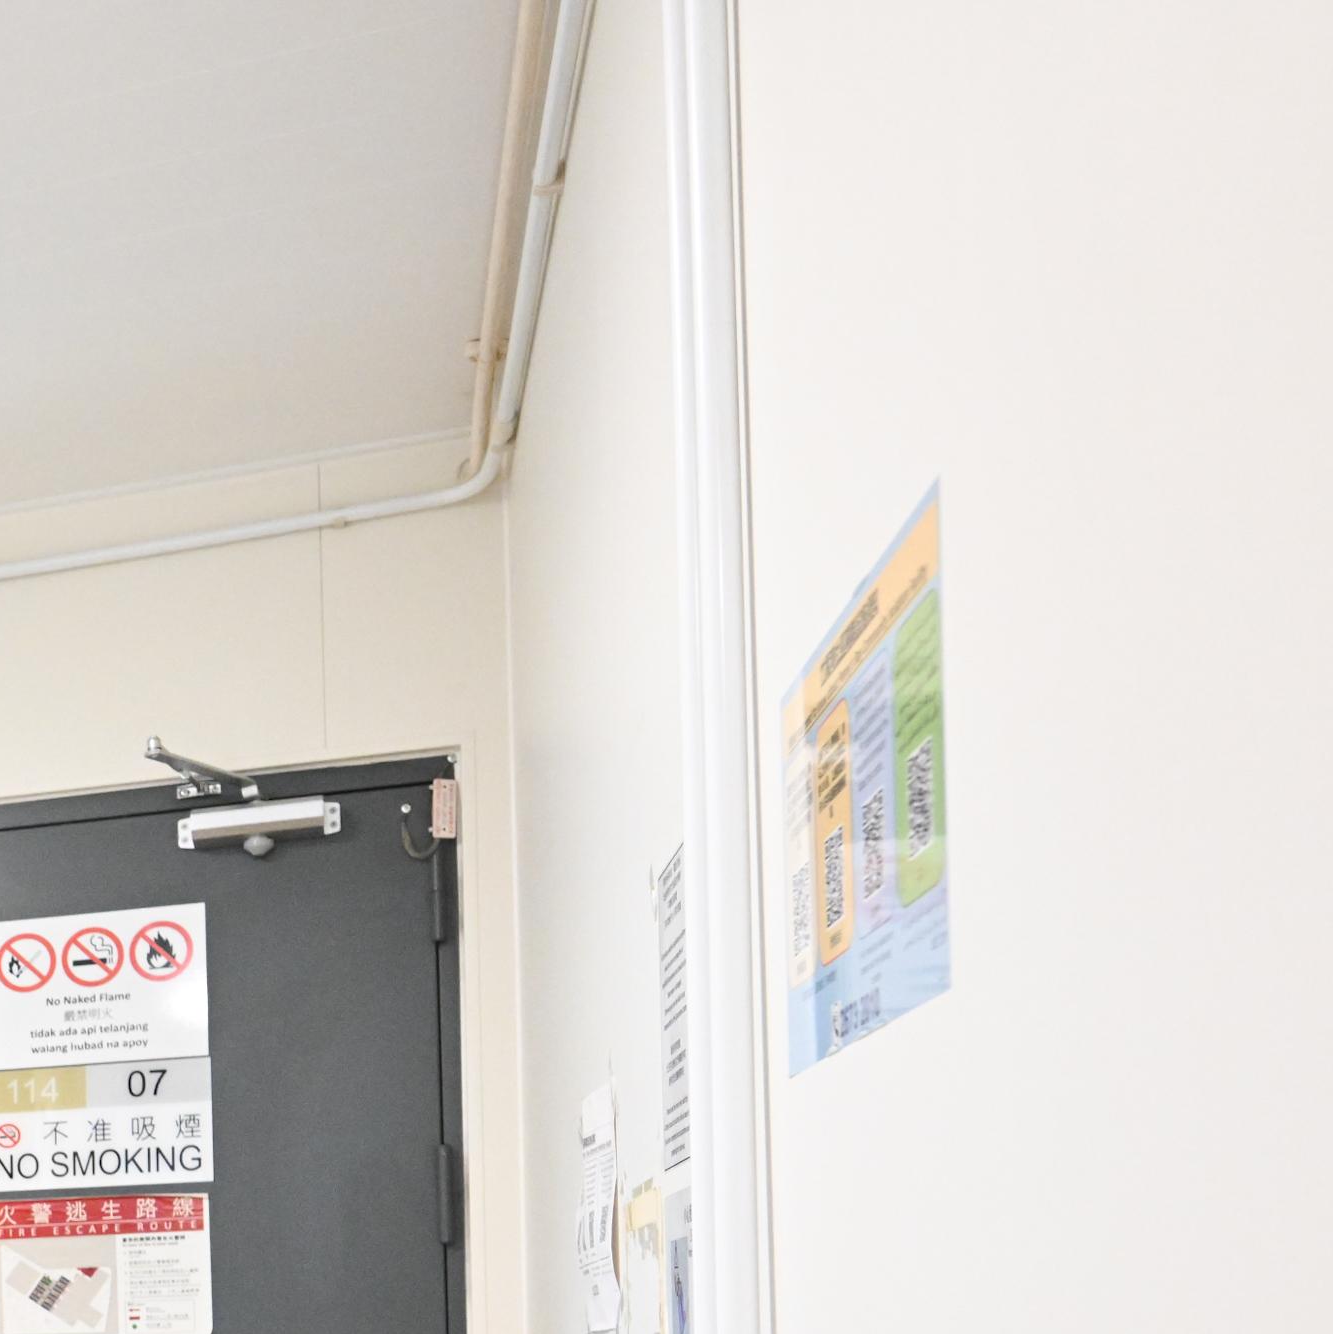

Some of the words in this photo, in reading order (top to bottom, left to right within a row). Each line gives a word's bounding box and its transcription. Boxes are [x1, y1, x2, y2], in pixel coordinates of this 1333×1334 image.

[46, 997, 60, 1006] No
[64, 995, 96, 1005] Naked
[100, 992, 131, 1001] Flame
[30, 1027, 56, 1038] tidak
[59, 1027, 78, 1037] ada
[80, 1025, 96, 1036] api
[100, 1022, 149, 1034] telanjang
[122, 1038, 149, 1049] apoy
[7, 1077, 60, 1105] 114
[128, 1069, 167, 1098] 07
[43, 1113, 202, 1146] 不准吸煙
[51, 1144, 202, 1178] SMOKING
[53, 1223, 121, 1236] ESCAPE
[137, 1220, 197, 1231] ROUTE
